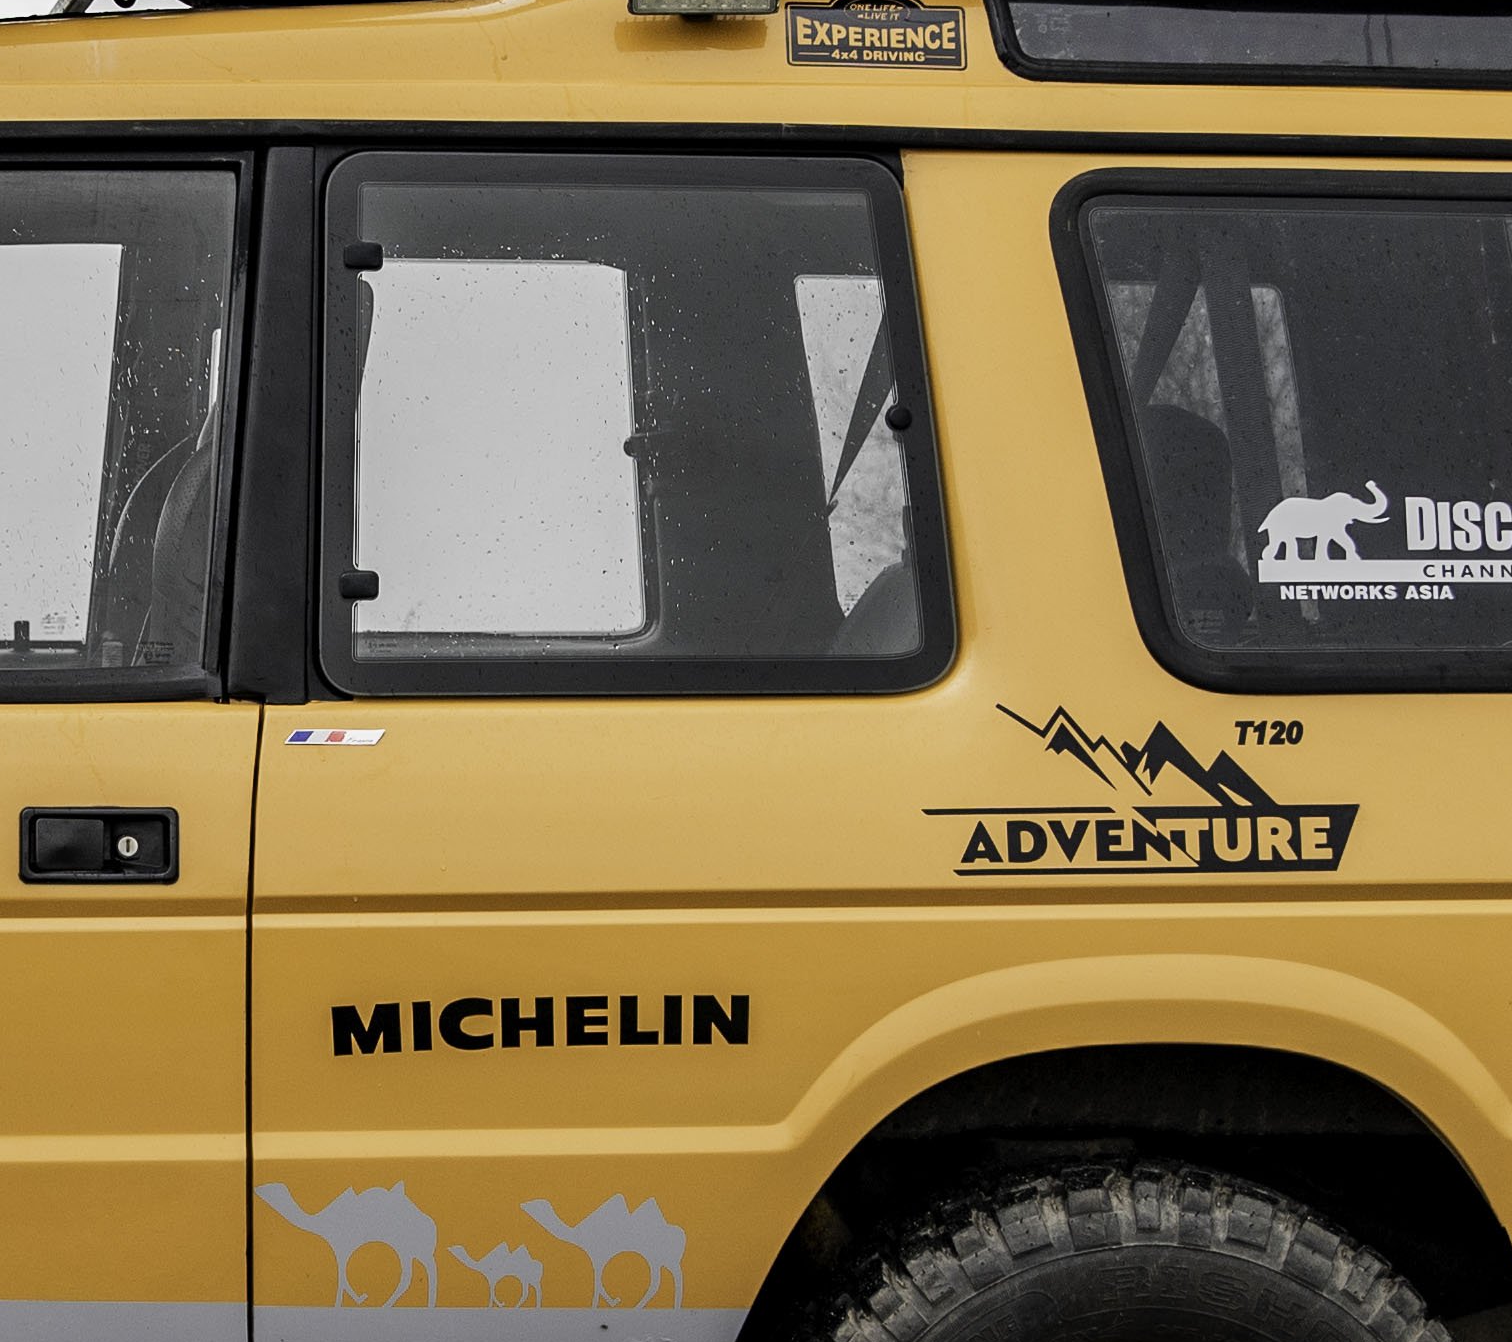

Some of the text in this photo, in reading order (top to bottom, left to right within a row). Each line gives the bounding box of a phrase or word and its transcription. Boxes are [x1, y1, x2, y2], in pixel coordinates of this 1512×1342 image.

[889, 12, 900, 21] IT
[796, 15, 956, 50] EXPERIENCE
[831, 49, 926, 62] 4x4 DRIVING
[1279, 584, 1455, 601] NETWORKS ASIA
[1234, 720, 1305, 746] T120
[960, 816, 1334, 864] ADVENTURE
[330, 994, 751, 1057] MICHELIN
